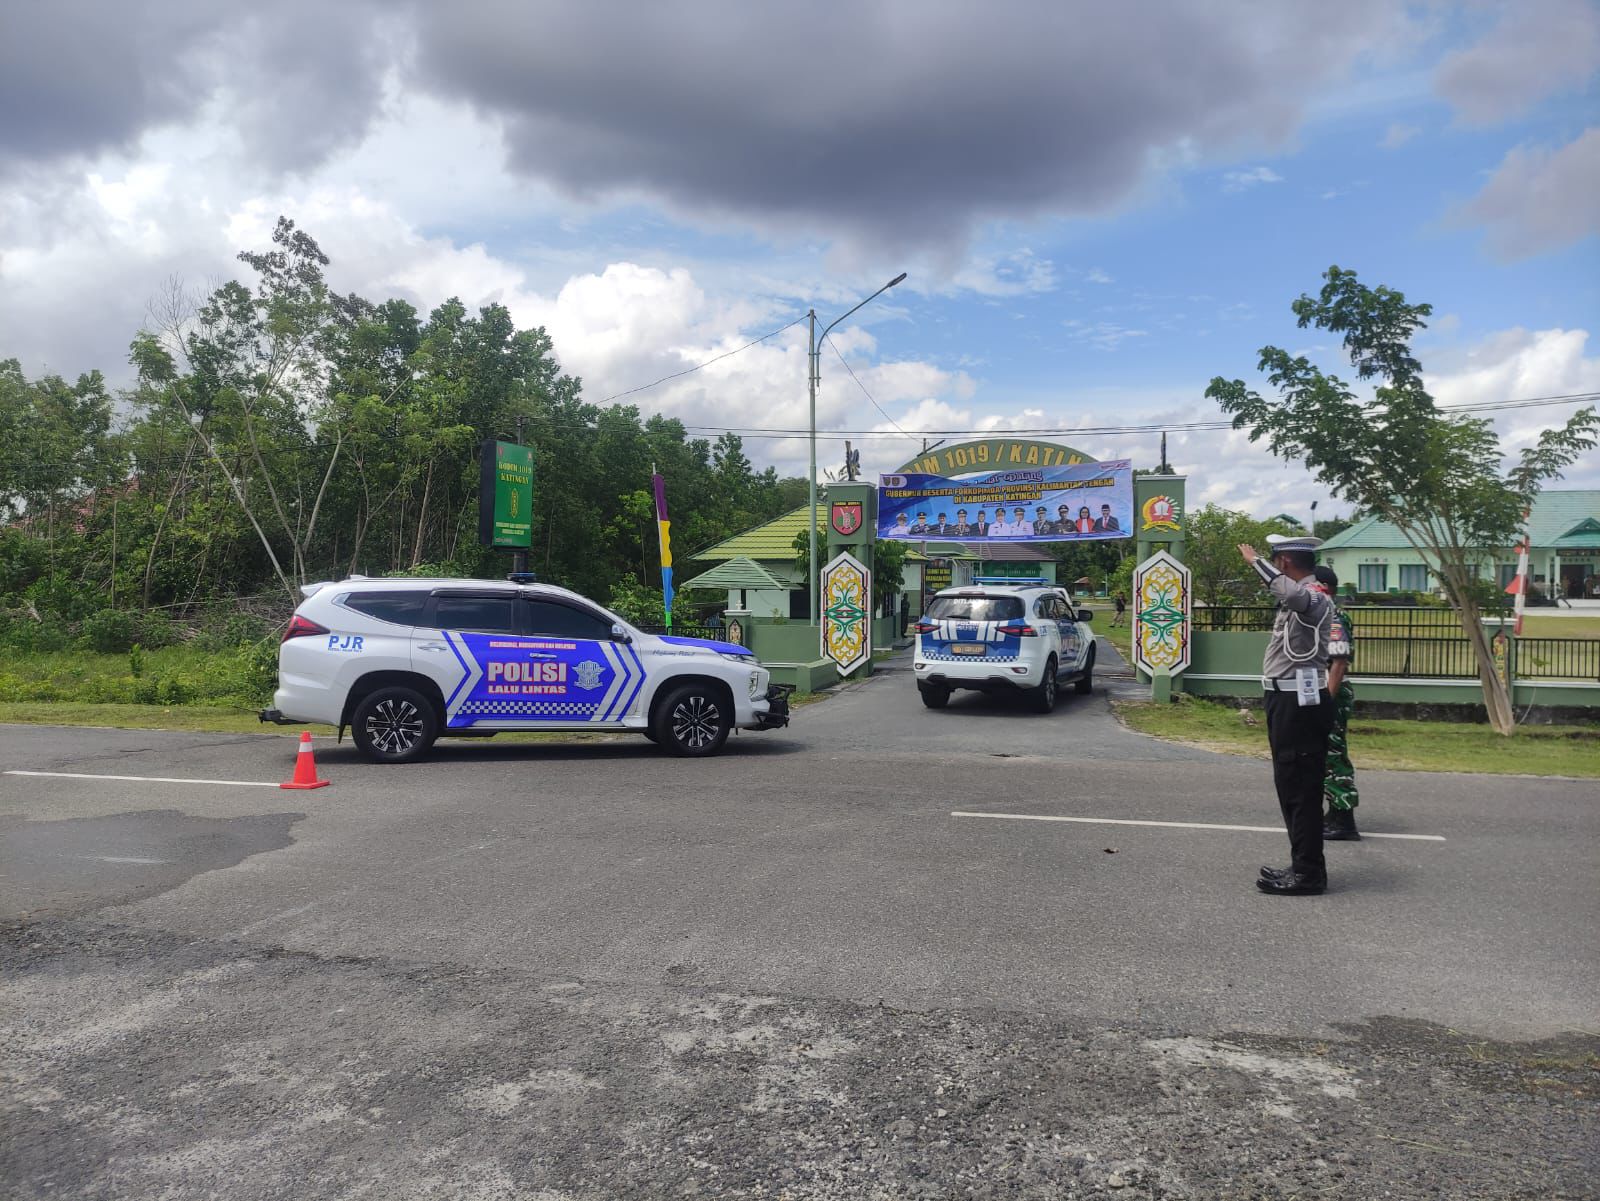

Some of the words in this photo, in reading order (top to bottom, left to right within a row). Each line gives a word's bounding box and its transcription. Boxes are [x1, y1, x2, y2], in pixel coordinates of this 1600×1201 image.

[945, 444, 989, 469] 1019
[1001, 484, 1035, 493] PROVINSI
[1085, 478, 1114, 488] TENGAH
[954, 495, 962, 504] DI
[963, 494, 1005, 503] KABUPATEN
[1006, 491, 1042, 501] KATINGAN
[328, 635, 364, 649] PJR
[488, 662, 567, 682] POLISI
[488, 685, 519, 694] LALU
[522, 685, 567, 694] LINTAS
